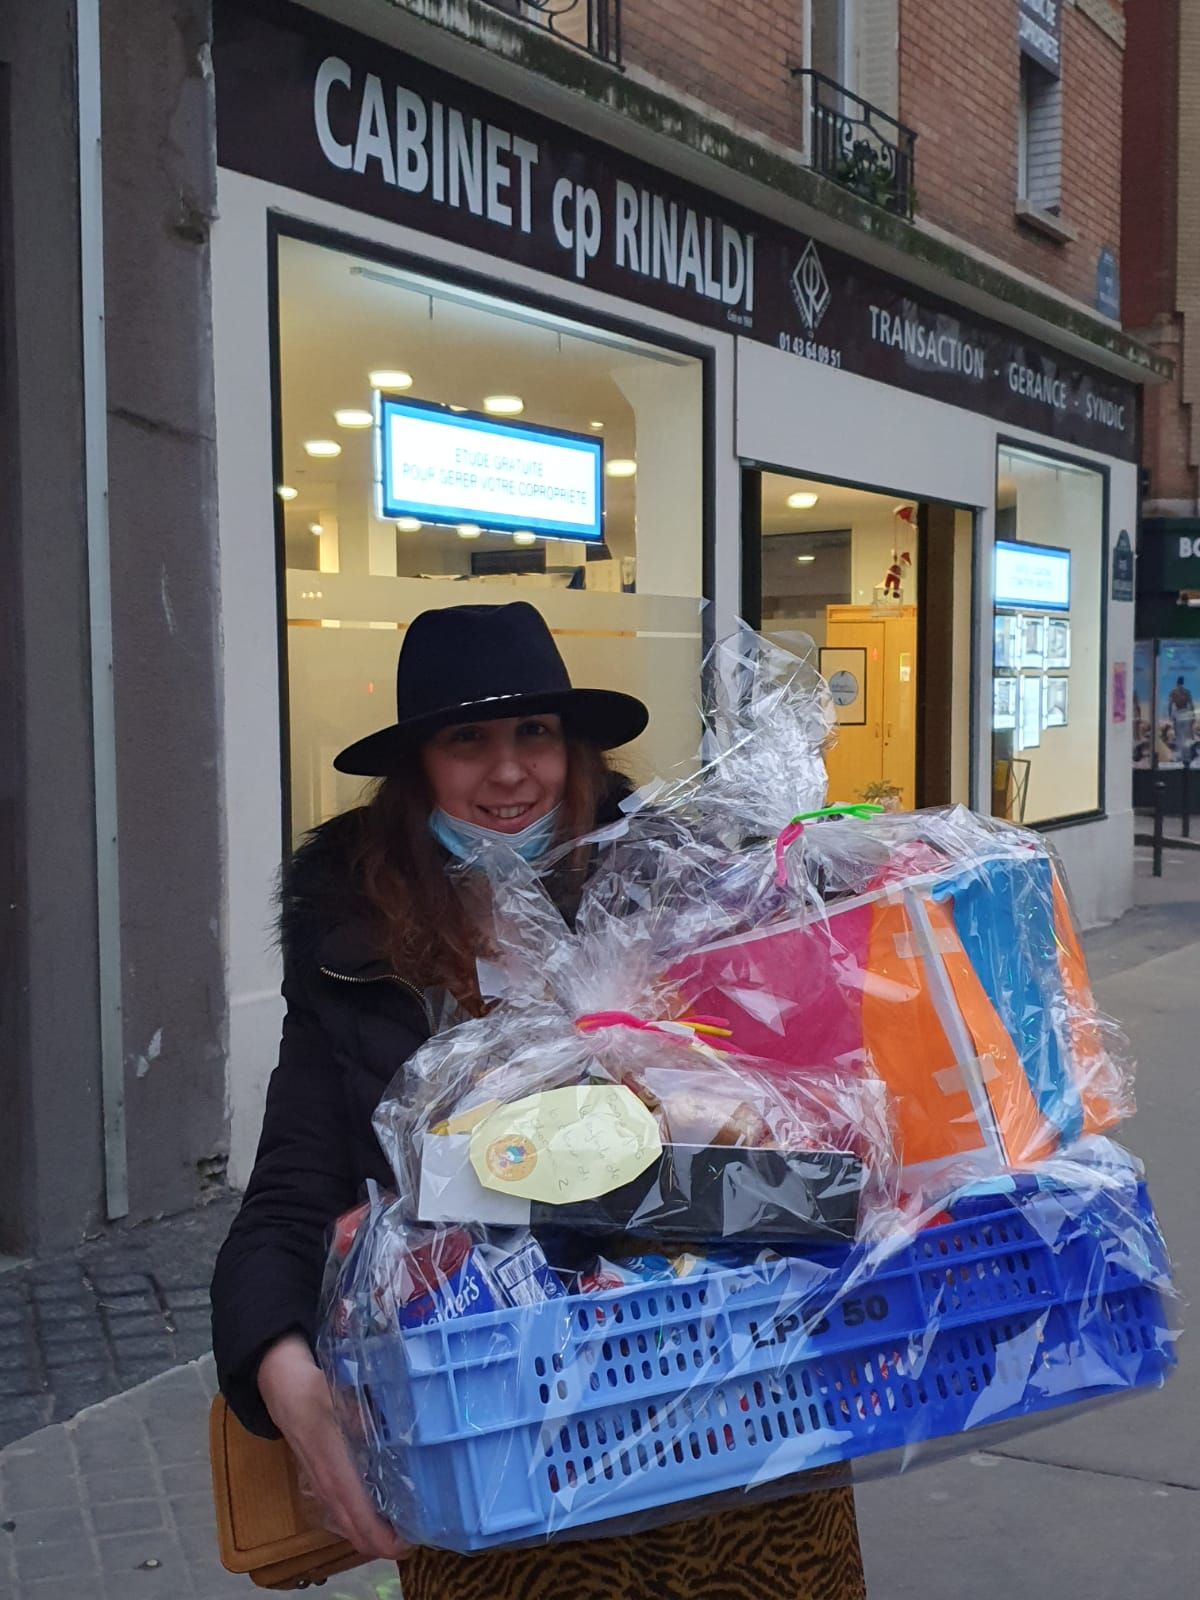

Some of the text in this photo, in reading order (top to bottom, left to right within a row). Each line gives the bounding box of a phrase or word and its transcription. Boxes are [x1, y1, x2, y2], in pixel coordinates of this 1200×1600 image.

[313, 55, 755, 312] CABINET cp RINALDI
[778, 331, 790, 352] 01
[805, 341, 817, 360] 64
[831, 349, 841, 368] 51
[869, 305, 984, 379] TRANSACTION
[1008, 362, 1067, 409] GERANCE
[1085, 393, 1125, 431] SYNDIC
[455, 447, 489, 469] ETUDE
[841, 1295, 888, 1327] 50
